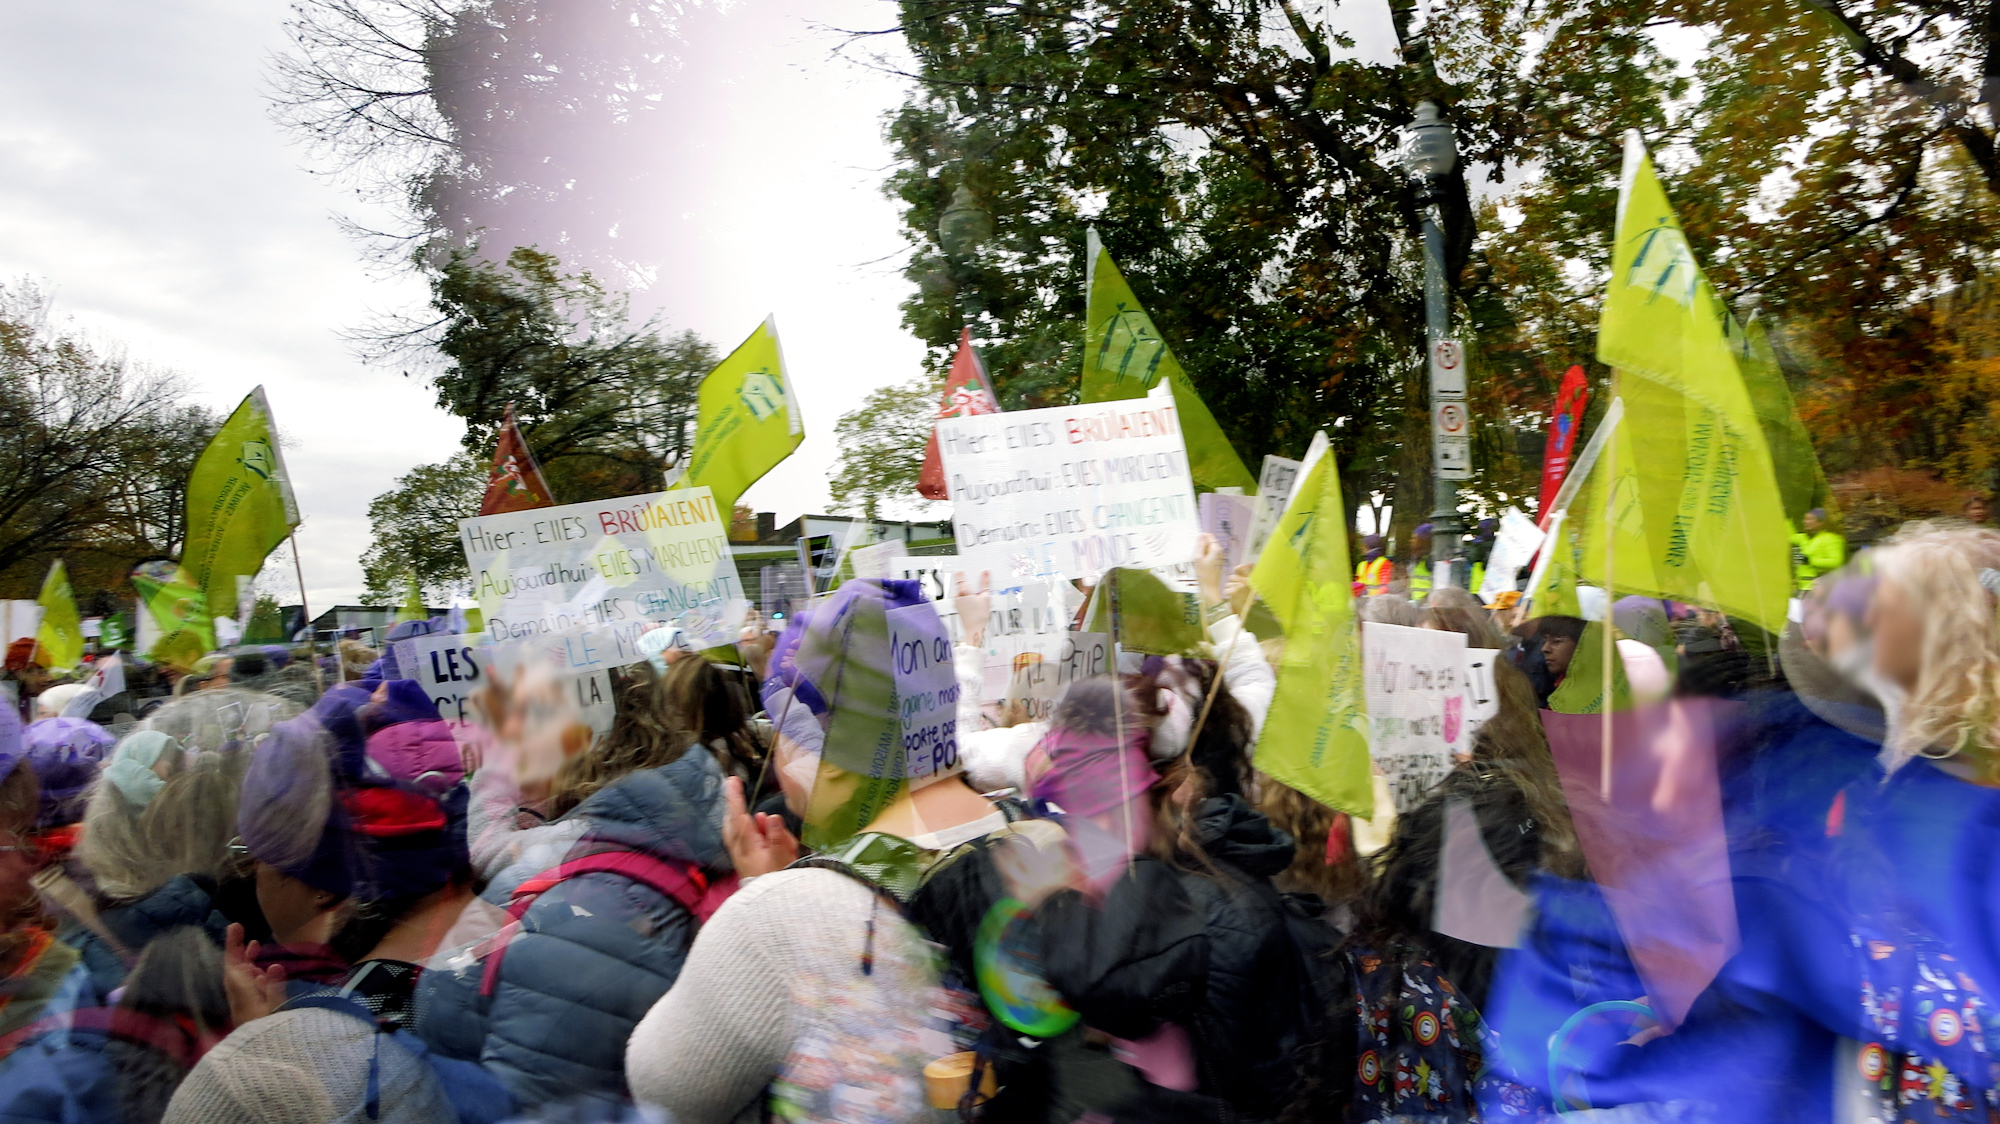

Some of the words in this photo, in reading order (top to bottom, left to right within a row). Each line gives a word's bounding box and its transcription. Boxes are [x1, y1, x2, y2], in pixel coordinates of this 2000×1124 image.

[466, 526, 526, 553] Hier:
[644, 535, 728, 571] MARCHENT
[489, 613, 578, 642] Demain:
[634, 576, 732, 616] CHANGENT
[430, 646, 480, 684] LES
[566, 632, 601, 667] LE
[932, 739, 963, 777] PO
